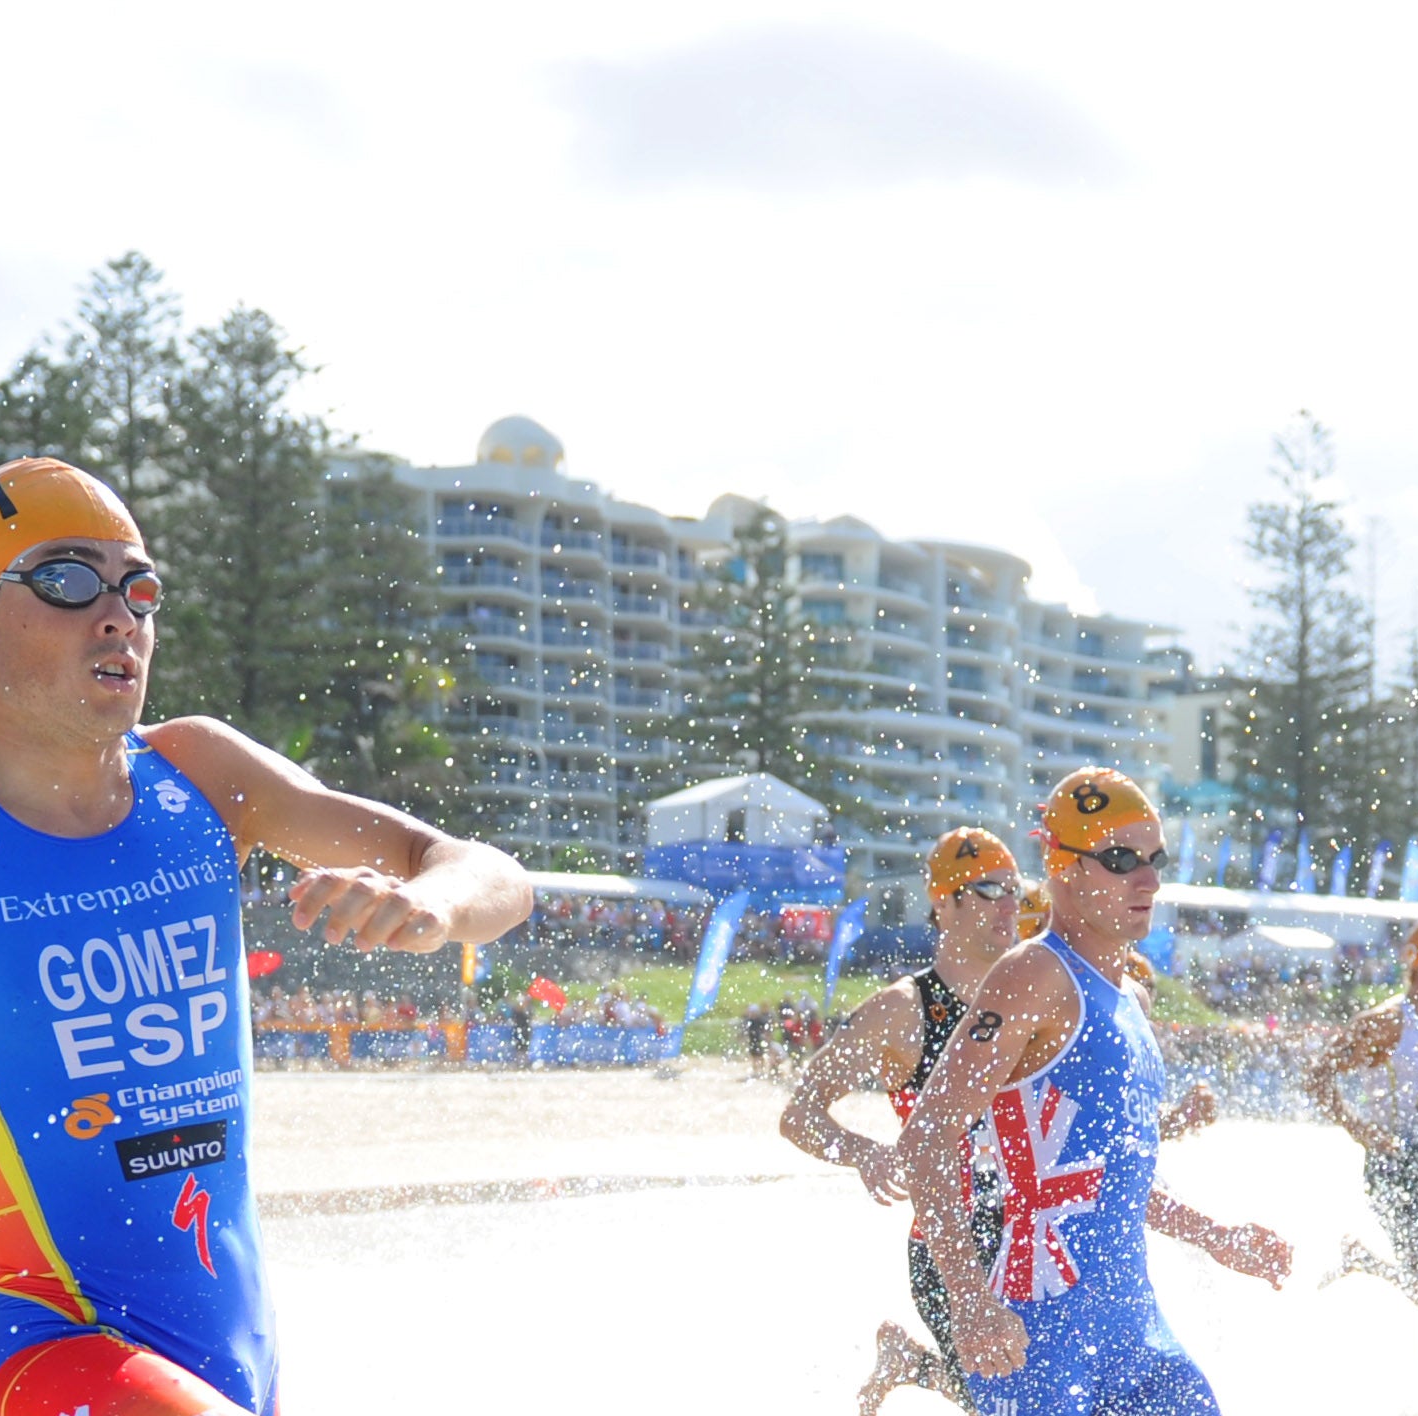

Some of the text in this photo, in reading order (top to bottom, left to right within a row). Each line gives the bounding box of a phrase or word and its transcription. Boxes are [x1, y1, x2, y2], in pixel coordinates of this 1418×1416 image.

[1072, 783, 1110, 814] 8
[956, 838, 978, 859] 4
[0, 859, 216, 923] Extremadura
[38, 915, 227, 1012] GOMEZ
[51, 991, 227, 1080] ESP
[969, 1011, 1002, 1042] 8
[117, 1067, 242, 1108] Champion
[139, 1091, 240, 1127] System
[129, 1140, 223, 1174] SUUNTO
